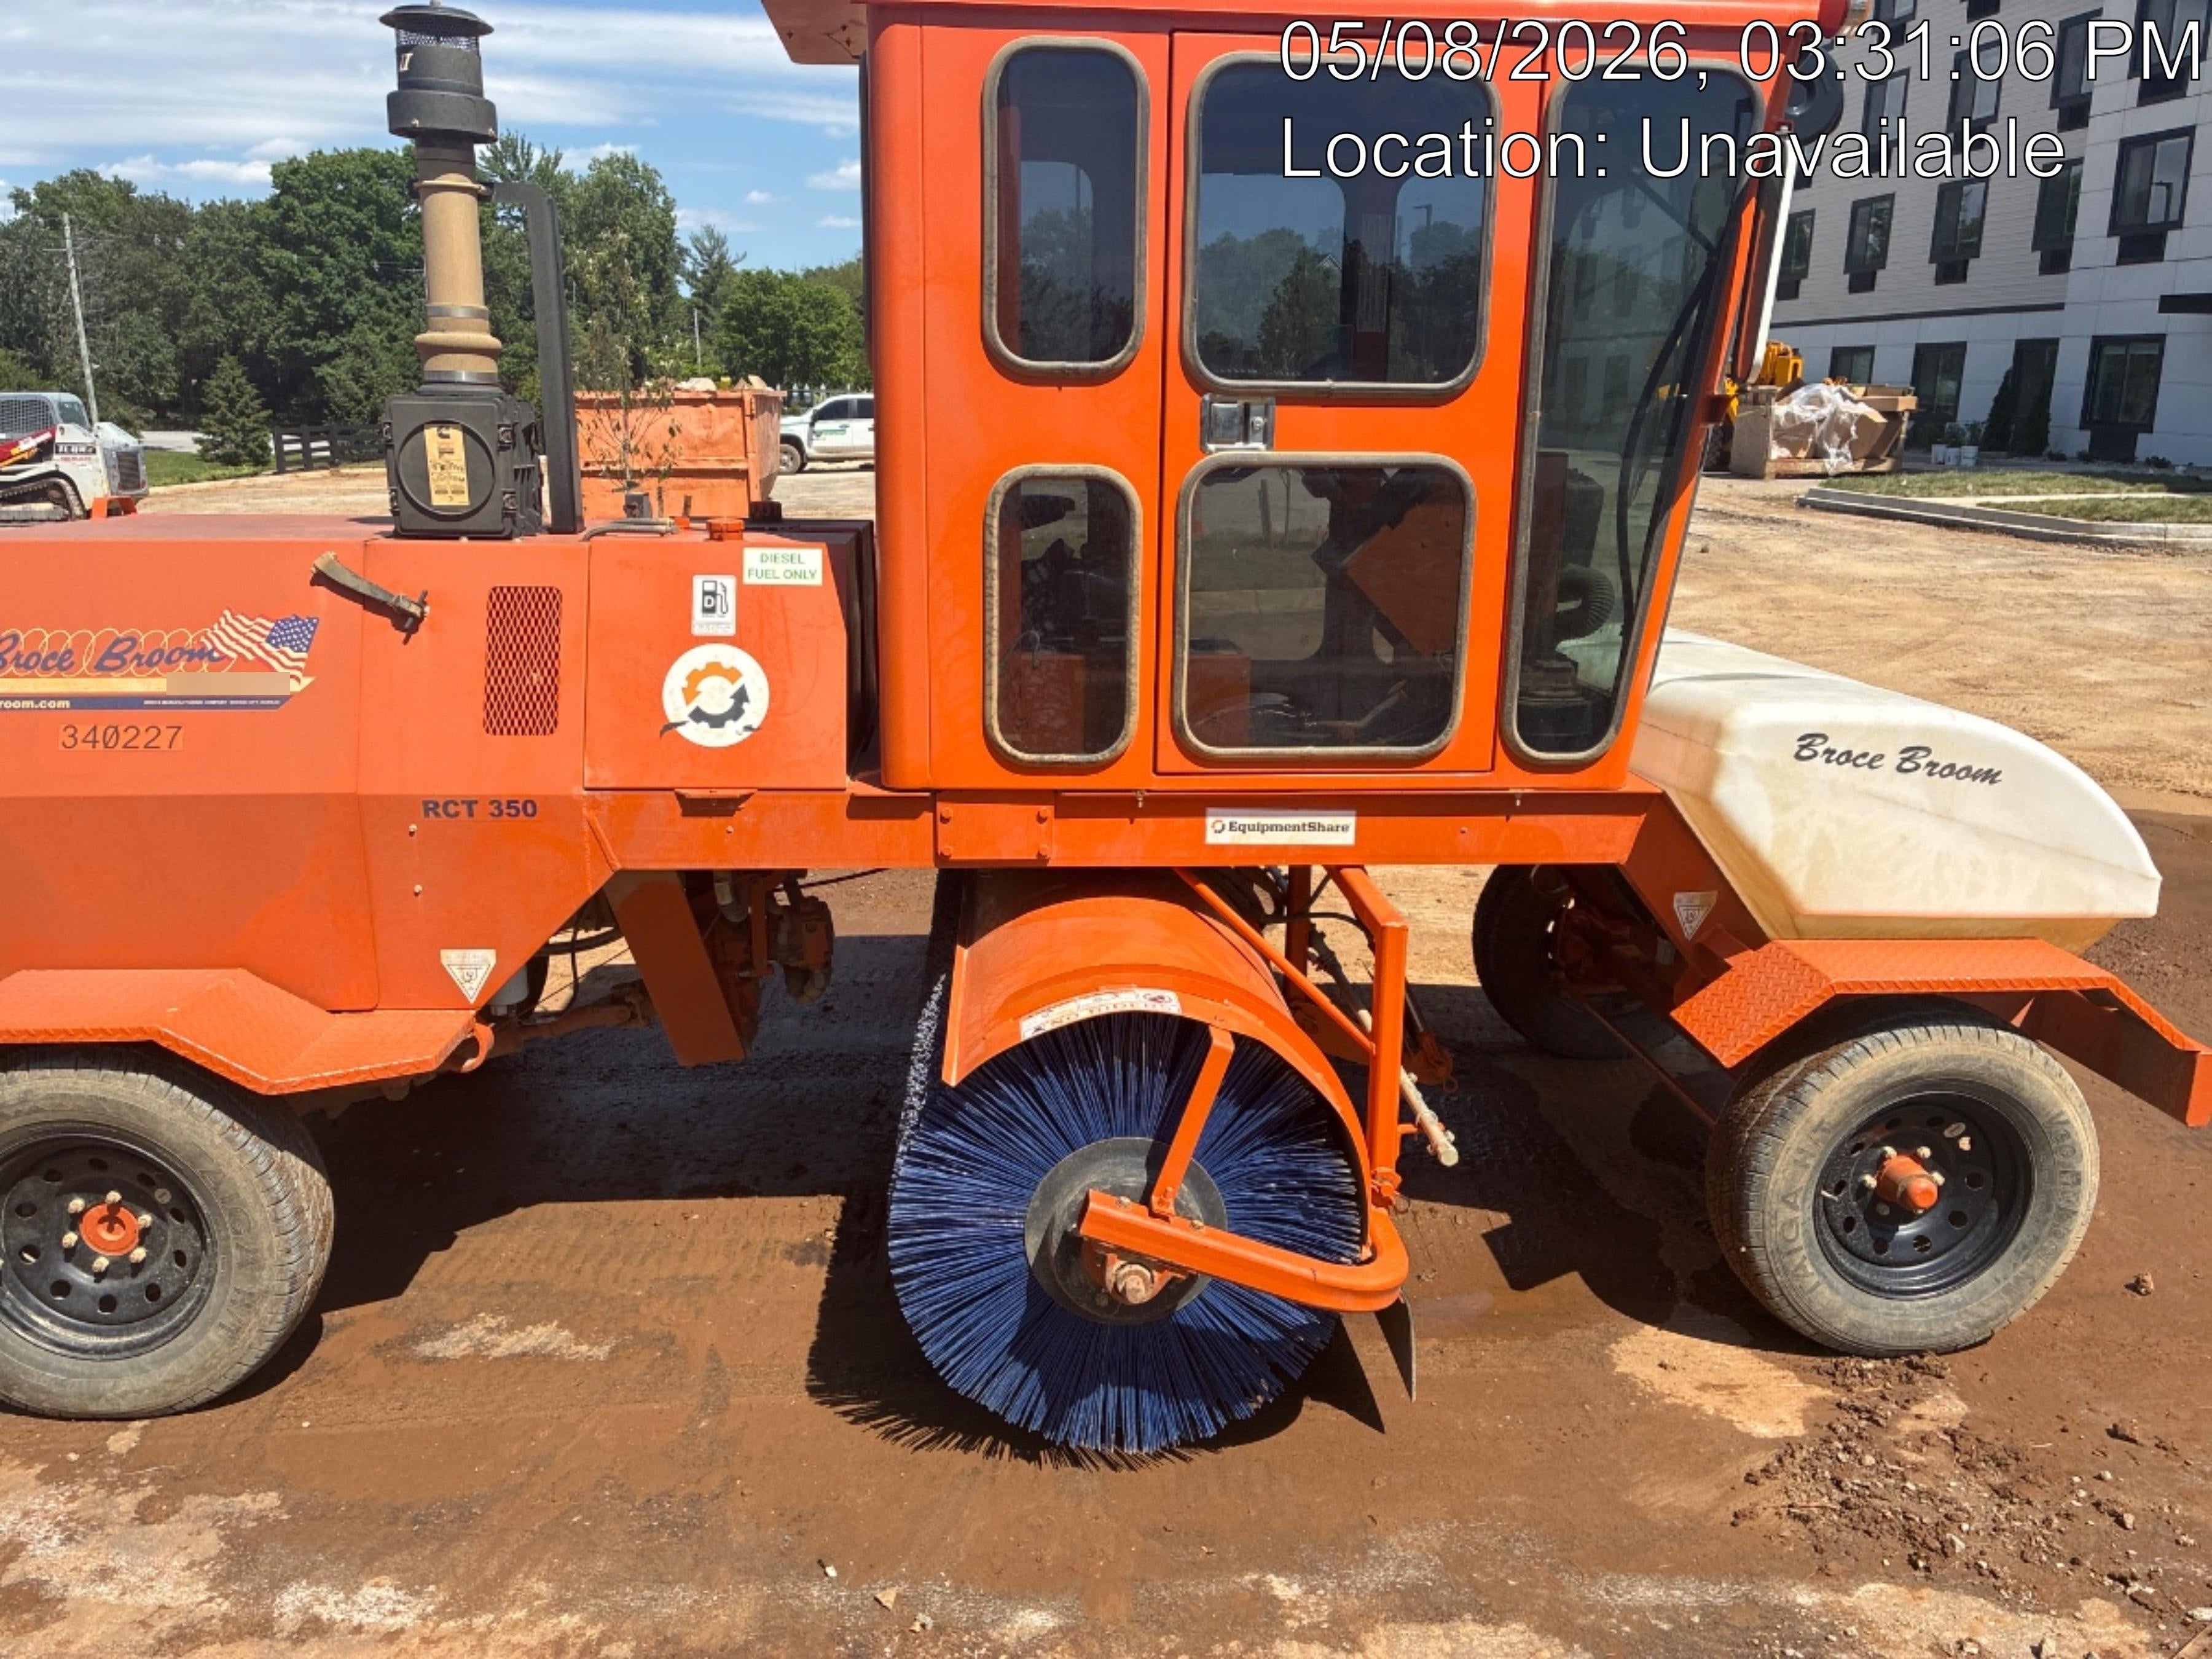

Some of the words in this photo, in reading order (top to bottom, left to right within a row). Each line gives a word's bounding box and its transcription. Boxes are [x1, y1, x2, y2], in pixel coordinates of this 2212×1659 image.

[760, 552, 804, 564] DIESEL
[748, 568, 779, 579] FUEL
[783, 568, 817, 580] ONLY
[704, 595, 715, 609] D
[94, 635, 225, 672] Broom
[61, 724, 182, 749] 340227
[1794, 732, 1886, 770] Broce
[1896, 745, 2002, 785] Broom
[422, 799, 478, 818] RCT
[488, 799, 538, 818] 350
[1228, 820, 1350, 834] EquipmentShare
